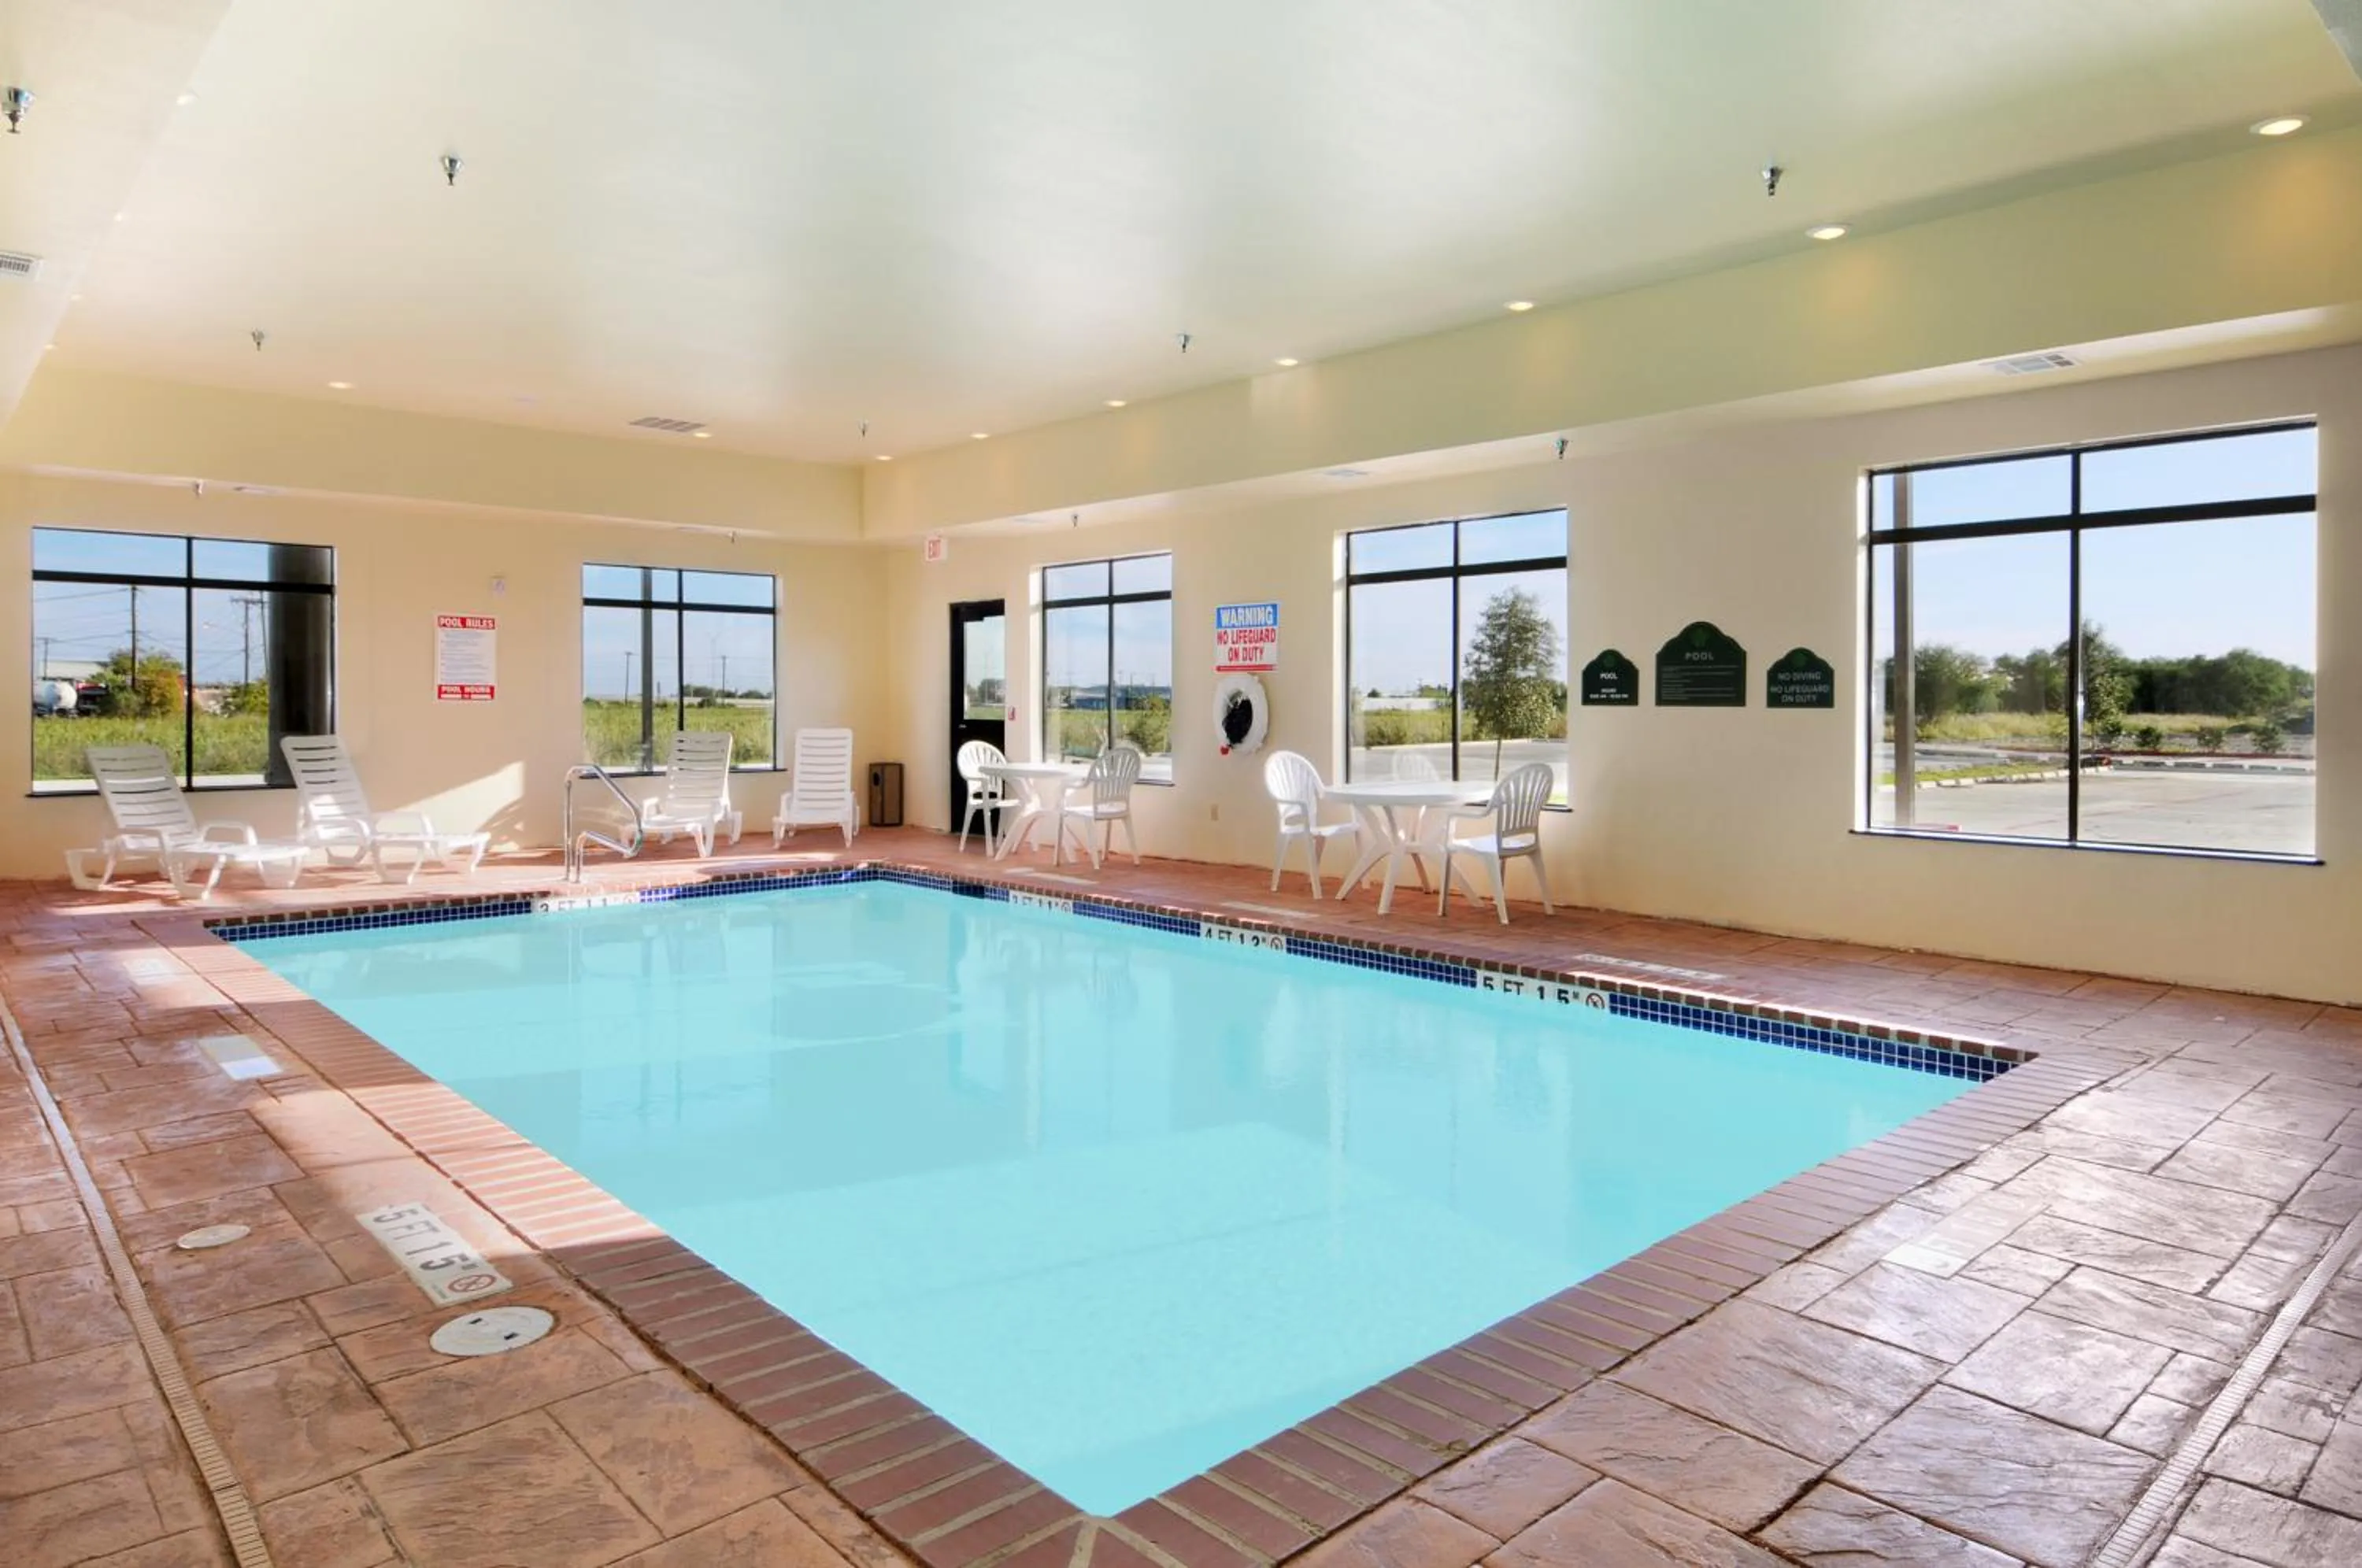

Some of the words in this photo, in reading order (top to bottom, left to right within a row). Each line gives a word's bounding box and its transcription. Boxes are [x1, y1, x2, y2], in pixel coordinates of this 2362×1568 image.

[440, 617, 461, 628] POOL
[466, 618, 494, 629] RULES
[1220, 605, 1273, 627] WARNING
[1217, 630, 1228, 645] NO
[1231, 628, 1276, 644] LIFEGUARD
[1228, 646, 1238, 661] ON
[1242, 646, 1264, 661] DUTY
[1685, 652, 1715, 661] POOL
[1503, 979, 1524, 996] FT
